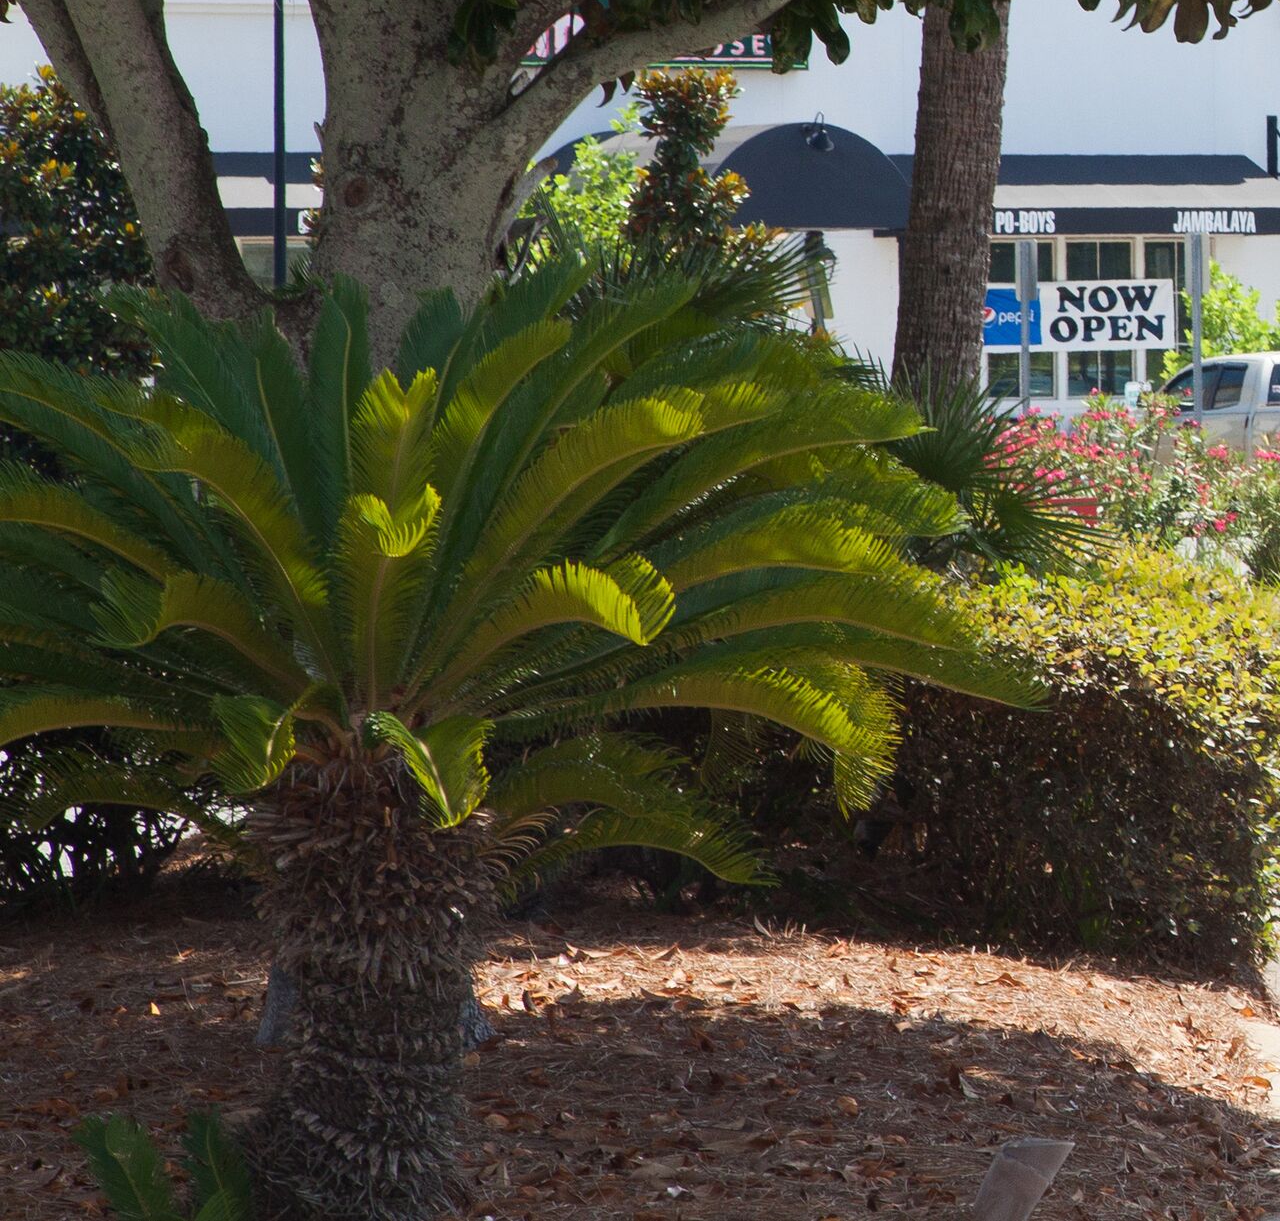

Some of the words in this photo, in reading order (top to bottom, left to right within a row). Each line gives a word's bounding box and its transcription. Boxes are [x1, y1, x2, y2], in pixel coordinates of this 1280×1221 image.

[995, 210, 1056, 234] PO-BOYS
[1173, 210, 1257, 234] JAMBALAYA
[1055, 285, 1158, 313] NOW
[998, 309, 1035, 326] pepi
[1049, 314, 1166, 343] OPEN
